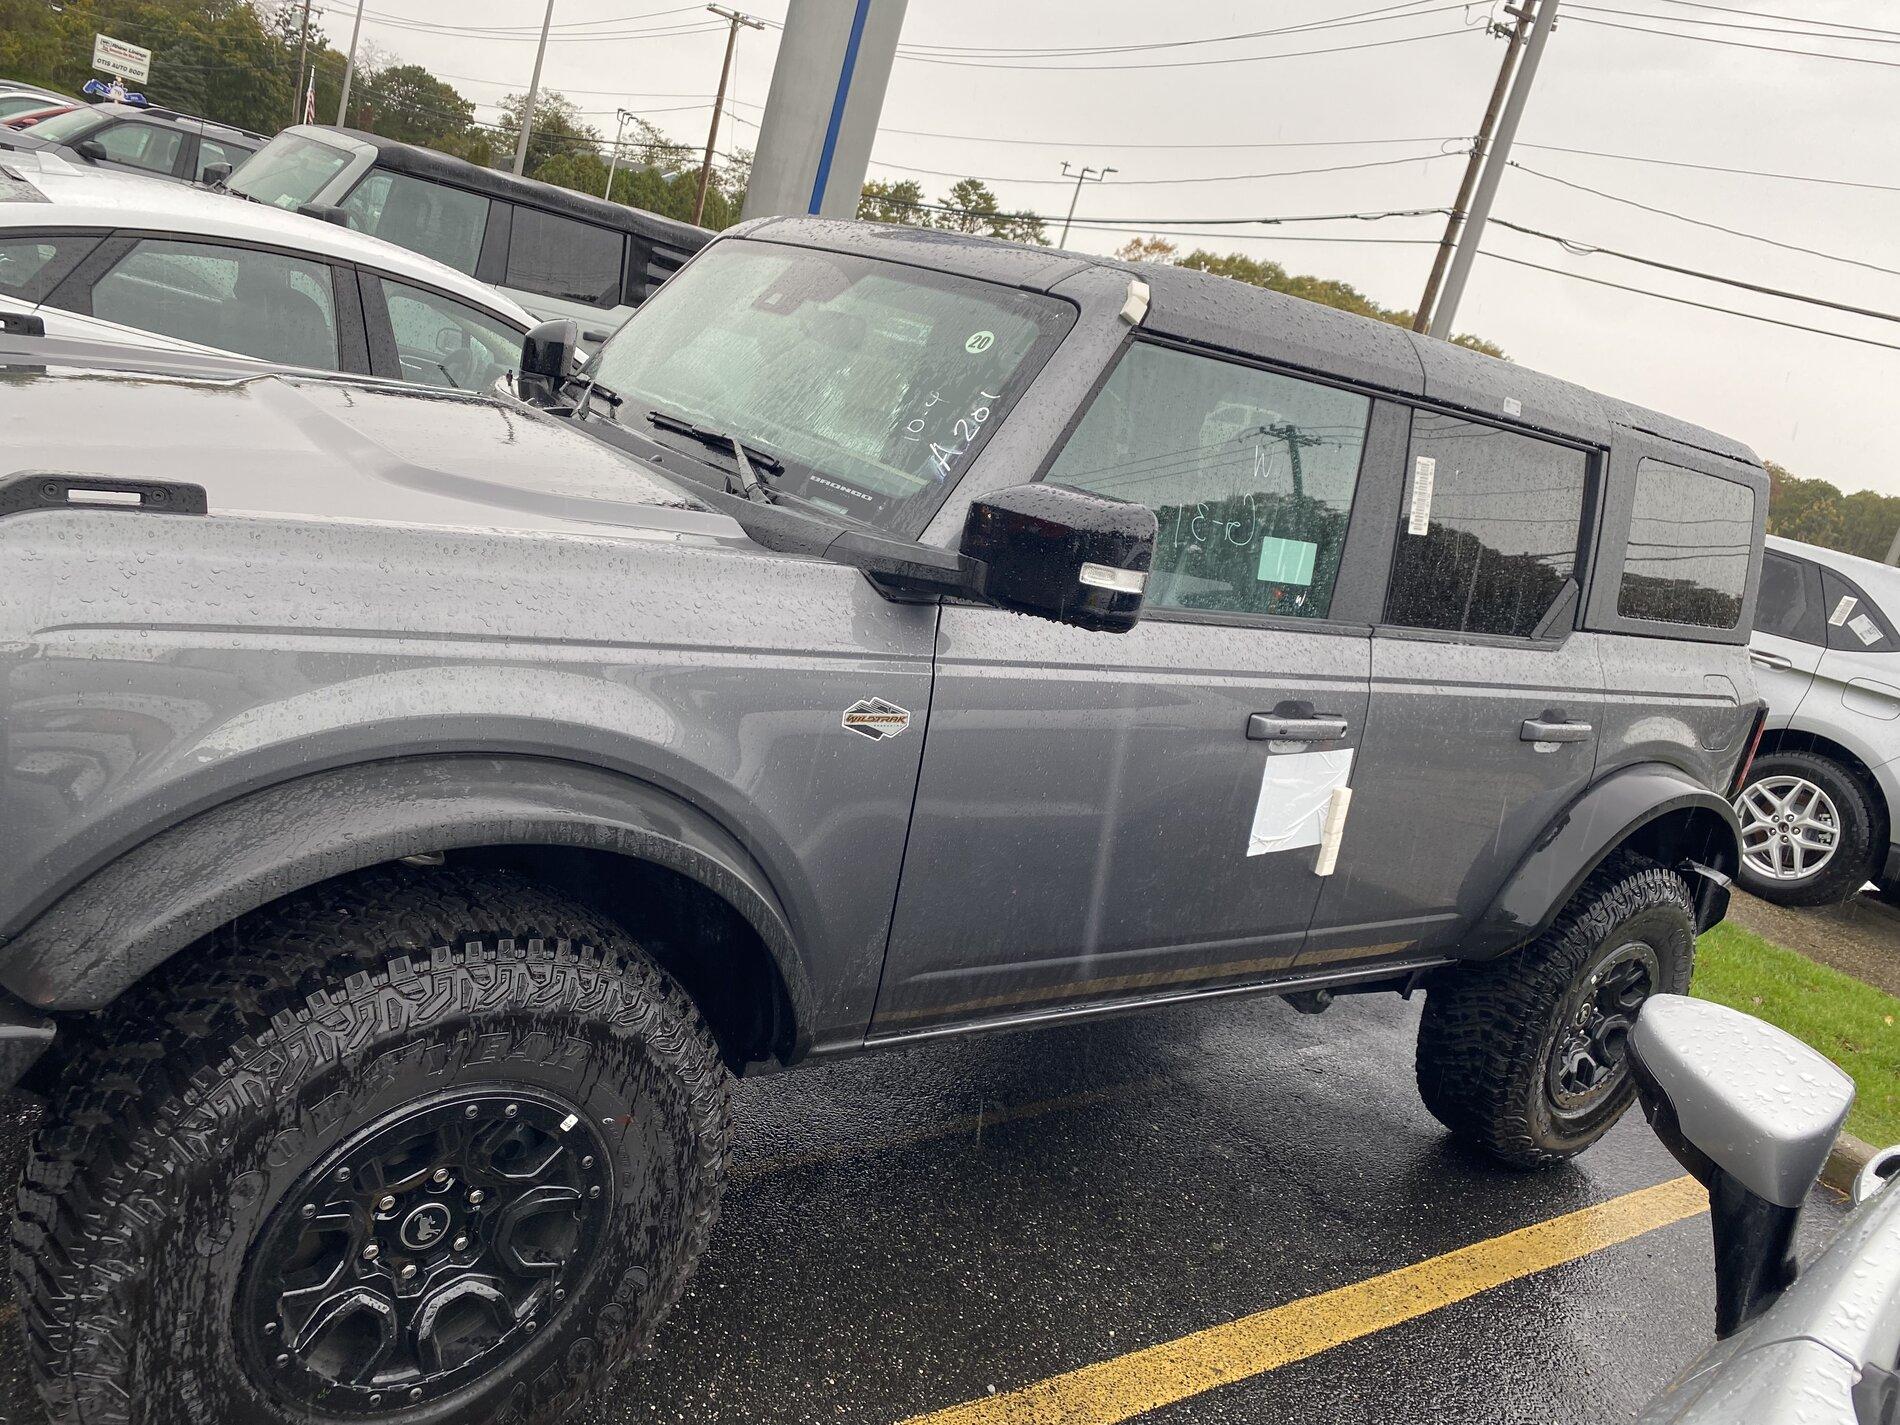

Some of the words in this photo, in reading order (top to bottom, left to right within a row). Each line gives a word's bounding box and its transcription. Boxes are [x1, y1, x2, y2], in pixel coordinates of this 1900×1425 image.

[97, 58, 111, 67] OTIS
[111, 62, 128, 72] AUTO
[129, 67, 144, 77] BODY
[967, 335, 991, 350] 20
[810, 475, 873, 501] BRONCO
[846, 714, 906, 724] WILDTRAK
